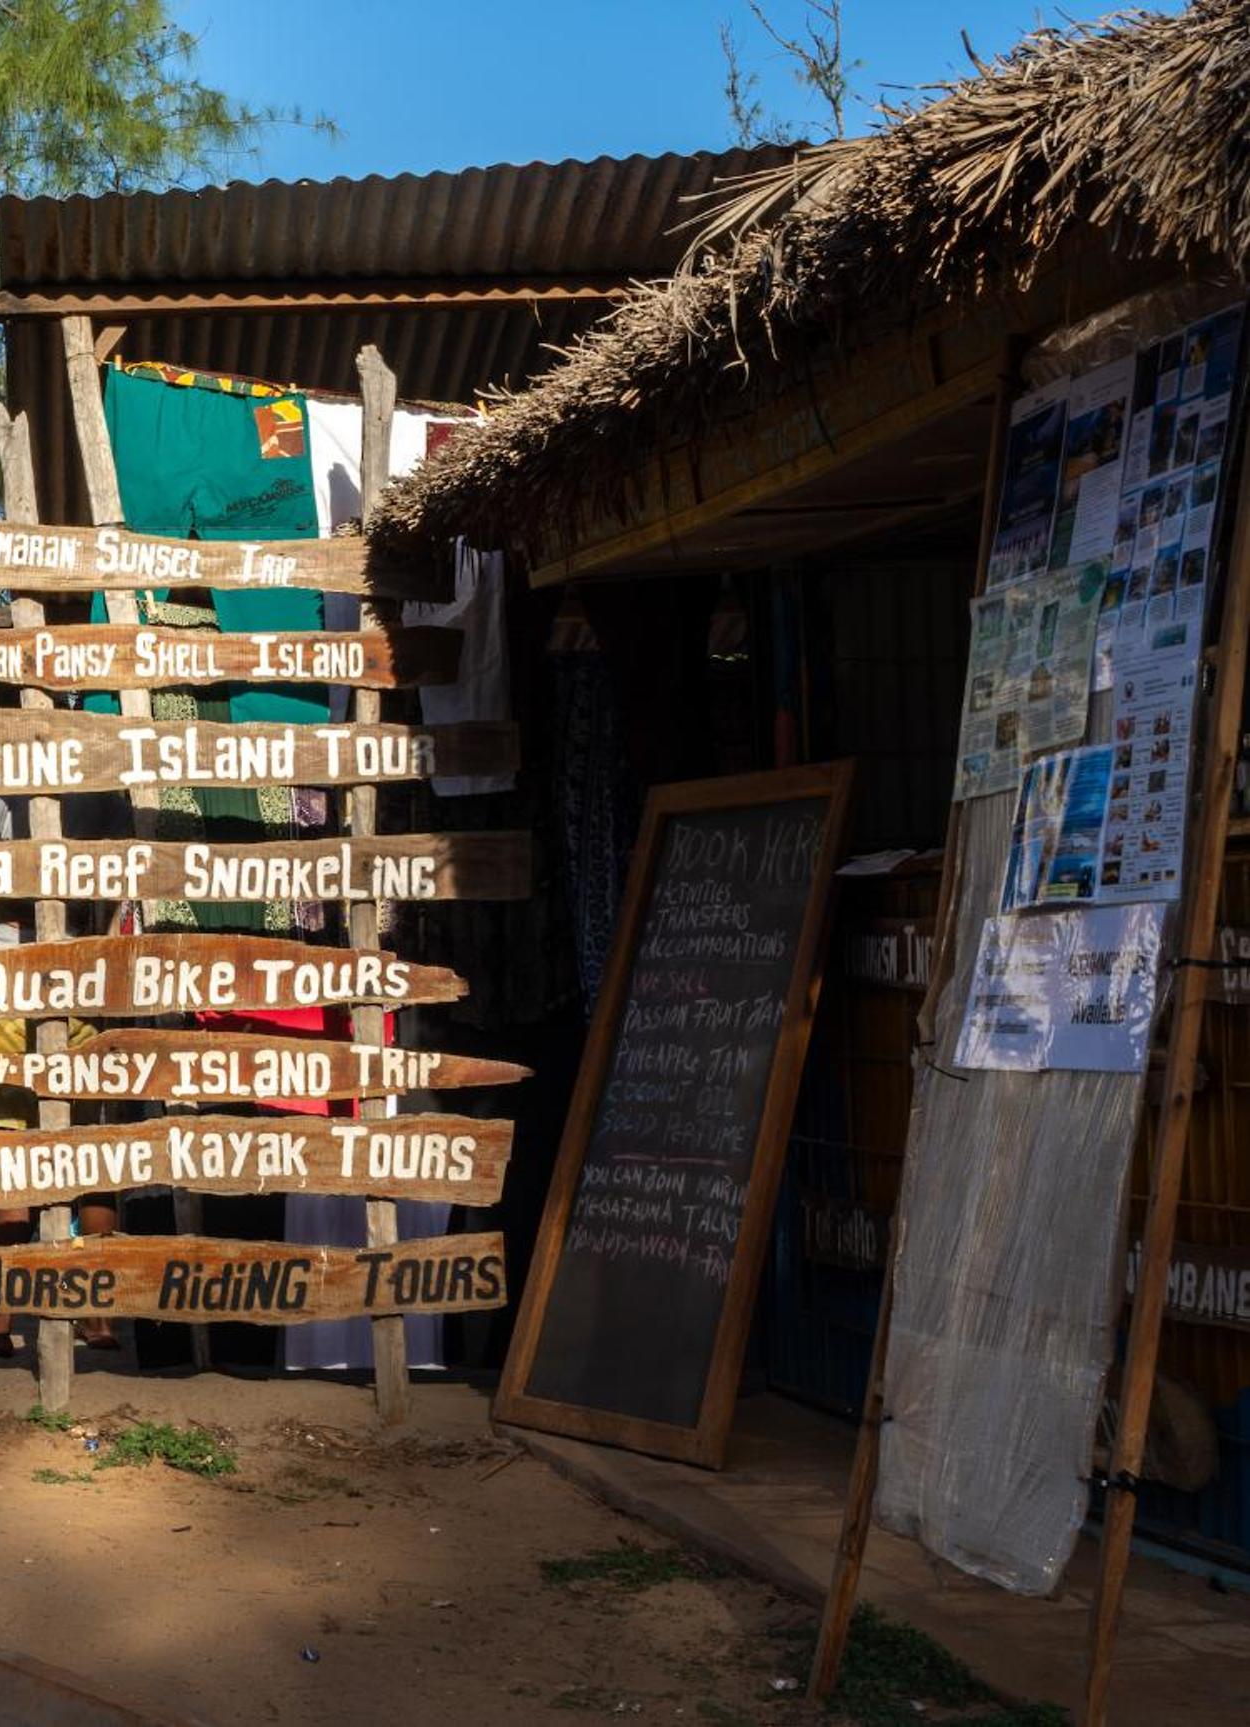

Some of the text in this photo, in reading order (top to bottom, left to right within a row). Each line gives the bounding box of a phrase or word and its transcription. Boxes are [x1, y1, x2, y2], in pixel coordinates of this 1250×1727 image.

[315, 728, 436, 779] TOUR
[40, 844, 152, 897] Reef
[133, 956, 236, 1007] Bike
[331, 1125, 477, 1181] TOURS
[355, 1252, 503, 1307] TOURS
